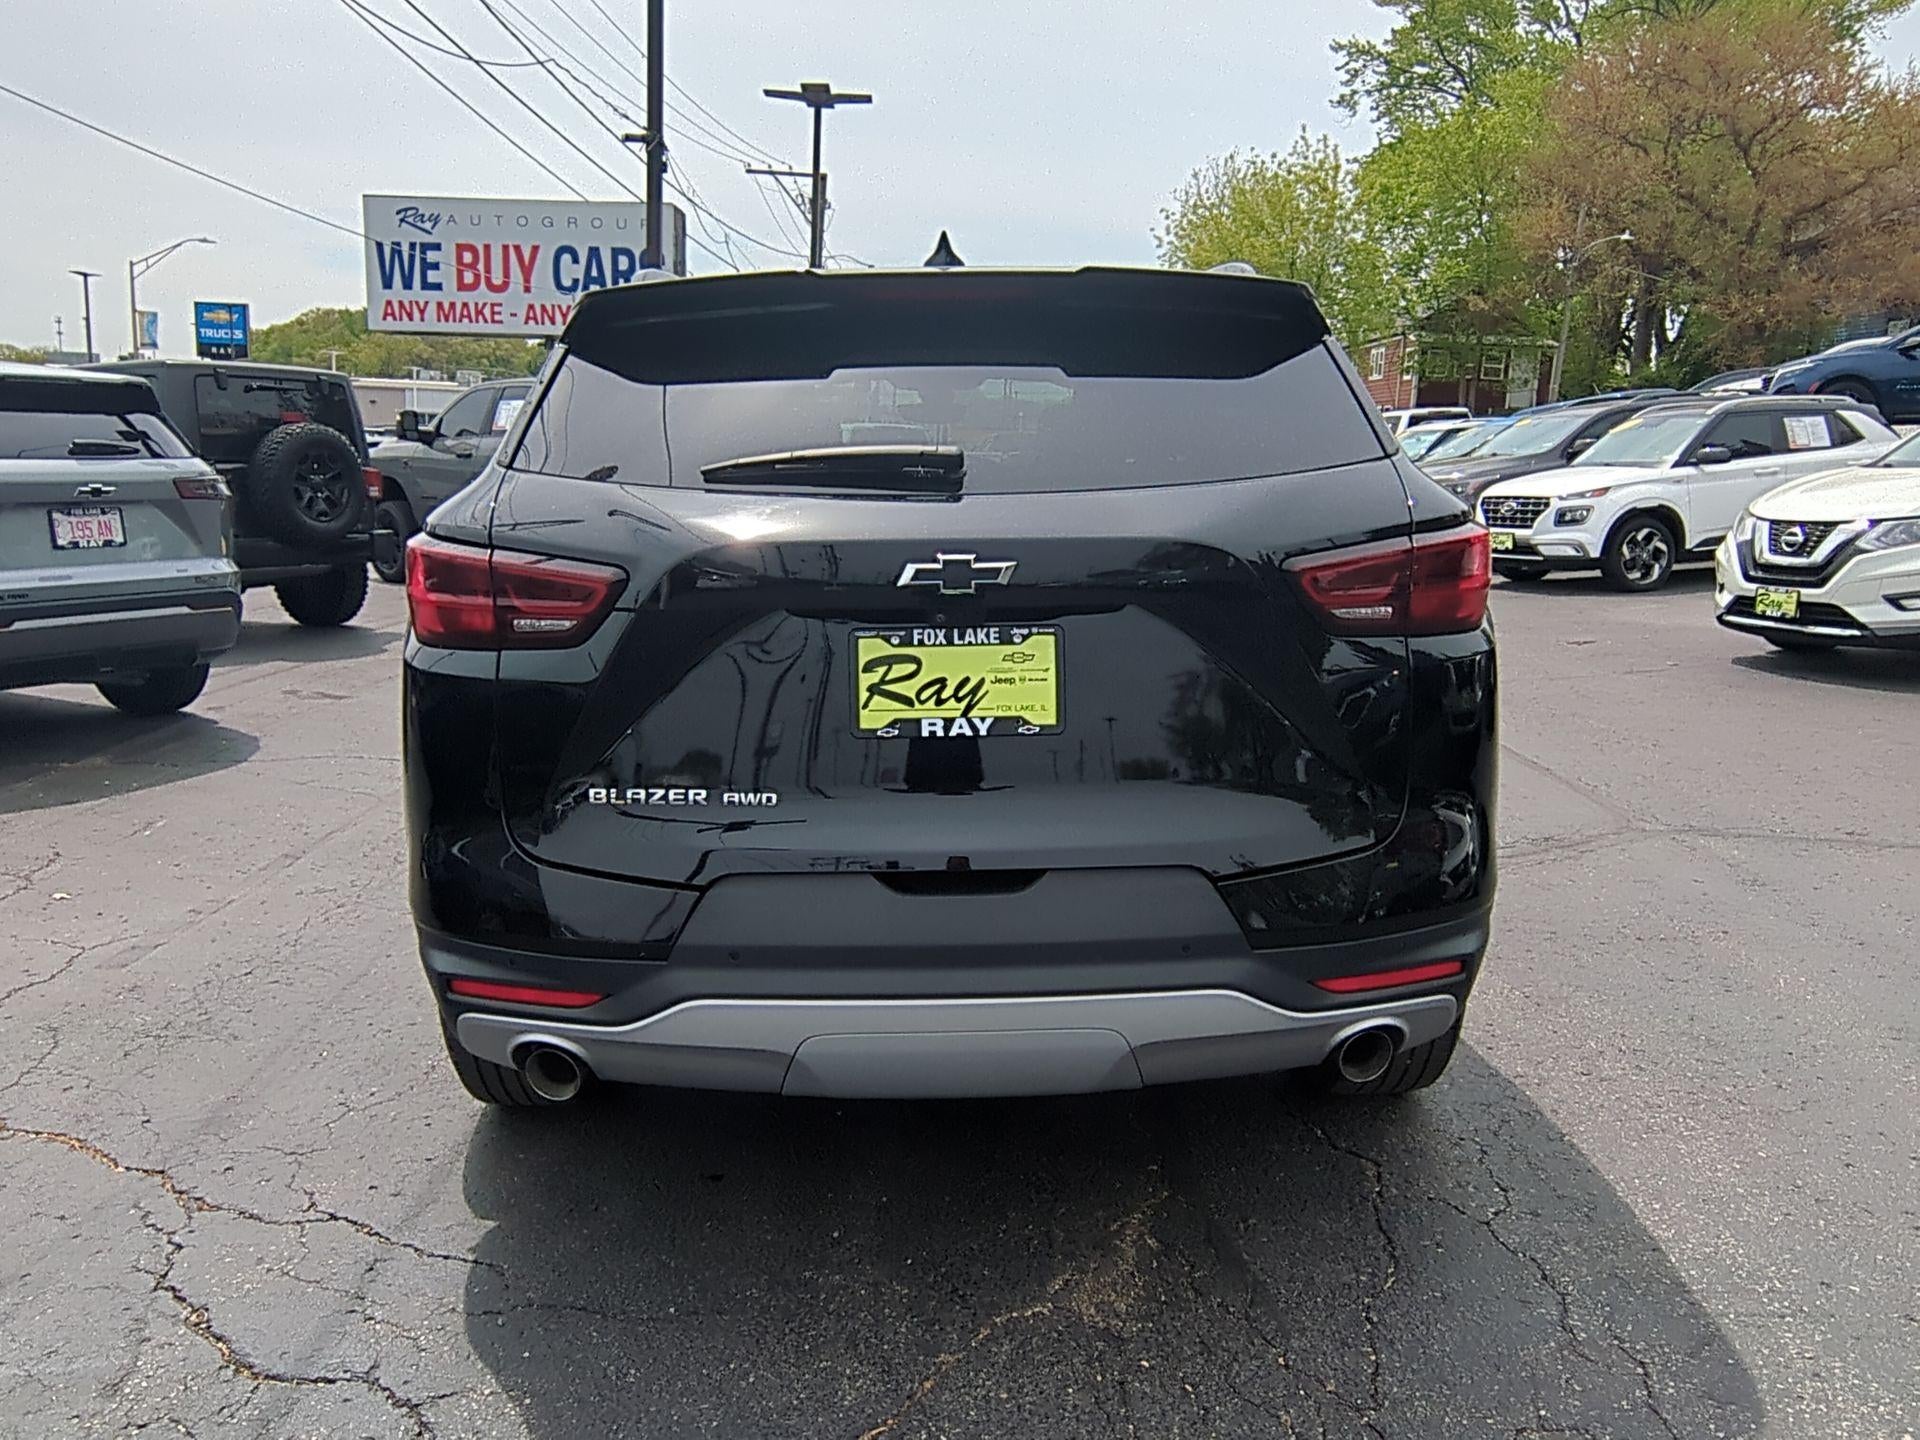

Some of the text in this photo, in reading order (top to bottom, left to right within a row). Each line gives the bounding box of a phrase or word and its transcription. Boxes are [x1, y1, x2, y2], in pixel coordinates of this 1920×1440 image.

[395, 206, 441, 235] Ray
[375, 241, 444, 292] WE
[455, 243, 540, 294] BUY
[382, 300, 429, 323] ANY
[436, 301, 504, 325] MAKE
[68, 520, 94, 540] 195
[97, 519, 113, 538] AN
[912, 629, 948, 645] FOX
[953, 627, 1000, 645] LAKE
[861, 653, 989, 717] Ray
[990, 675, 1016, 686] Jeep
[996, 704, 1012, 712] FOX
[920, 717, 995, 737] RAY
[588, 788, 778, 807] BLAZER AWD
